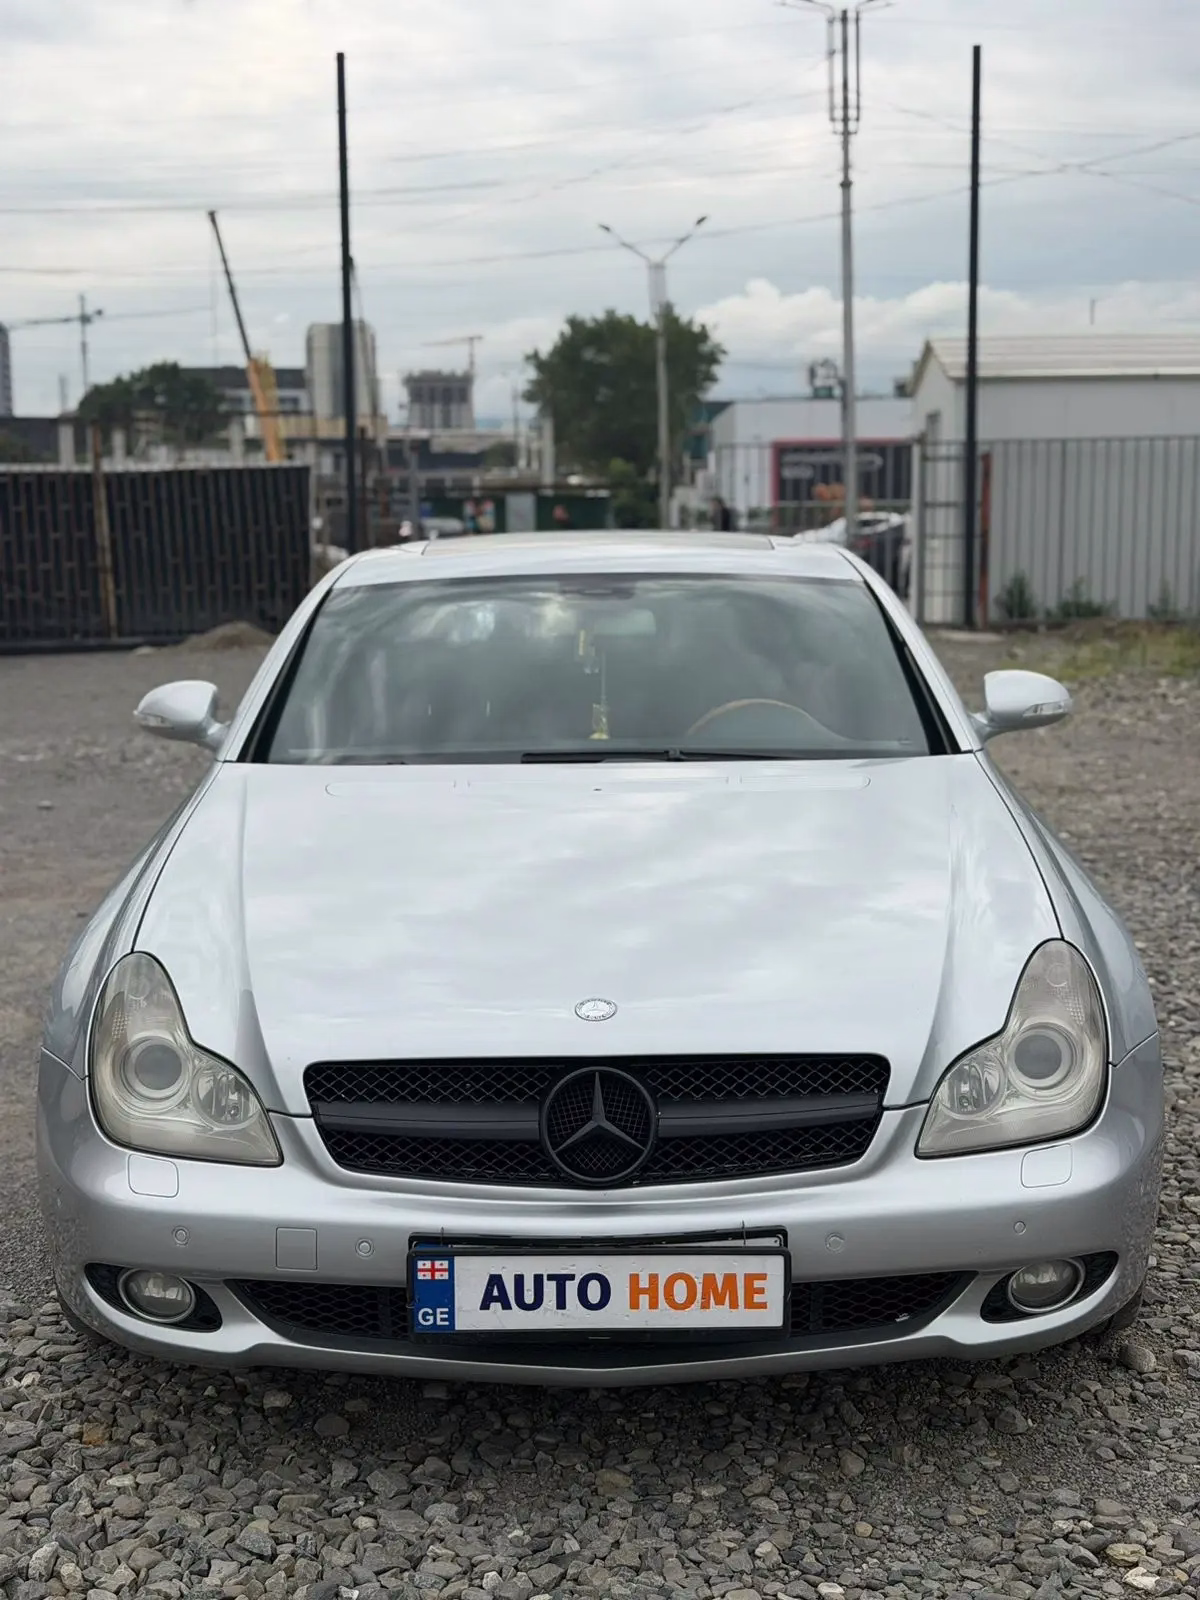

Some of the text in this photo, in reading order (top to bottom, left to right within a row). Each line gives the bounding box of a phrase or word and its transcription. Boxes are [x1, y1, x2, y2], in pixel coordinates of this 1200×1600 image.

[479, 1272, 768, 1311] AUTO HOME
[418, 1307, 450, 1326] GE
